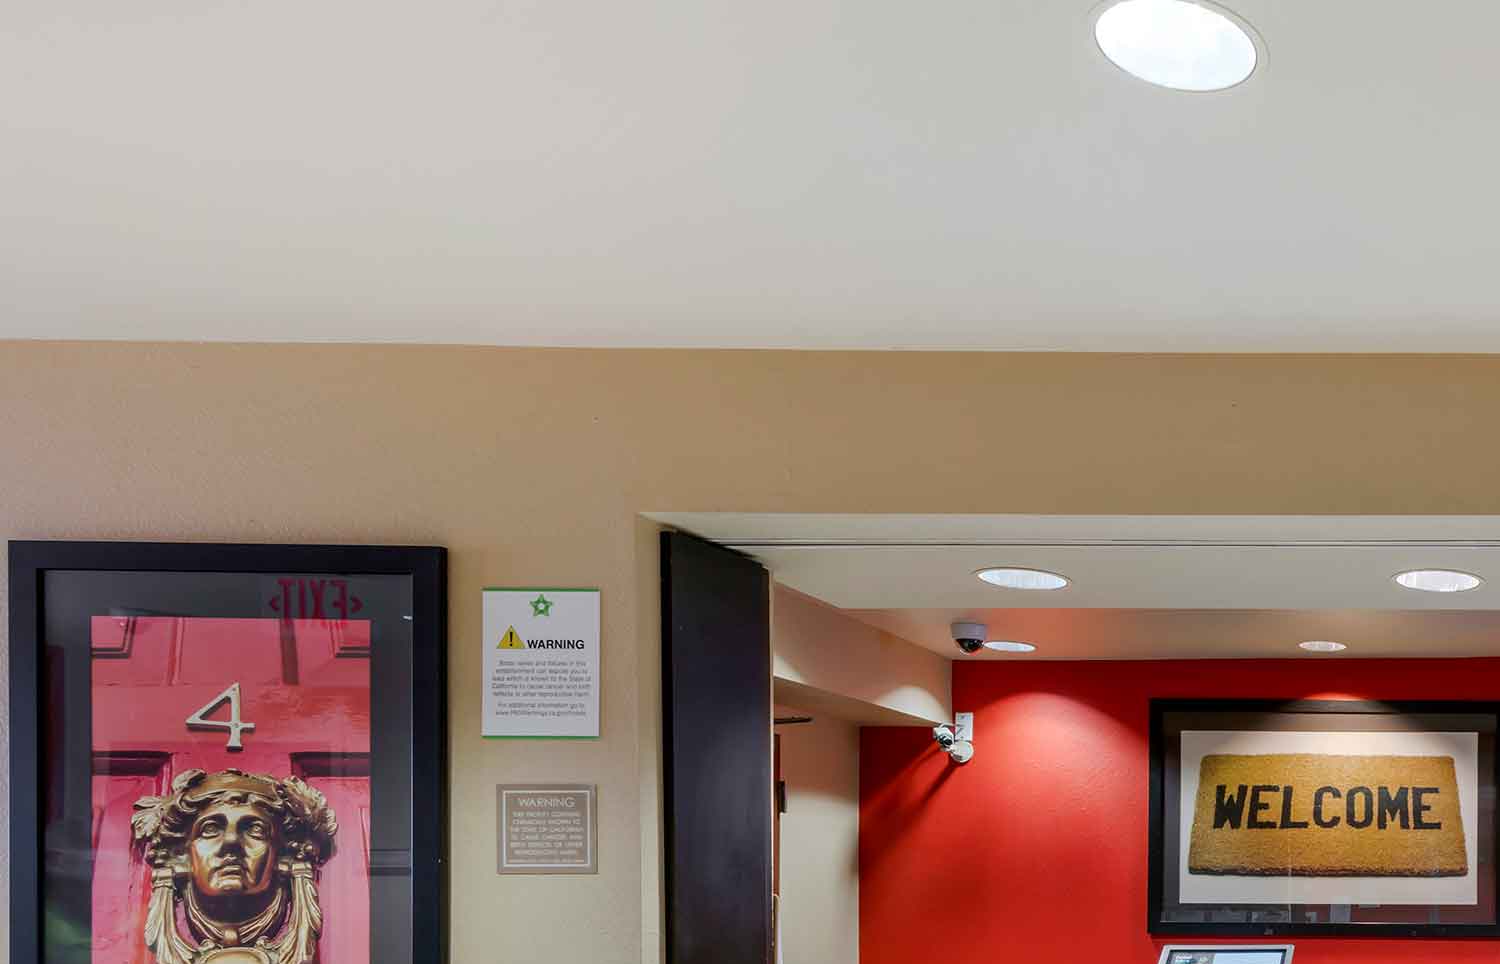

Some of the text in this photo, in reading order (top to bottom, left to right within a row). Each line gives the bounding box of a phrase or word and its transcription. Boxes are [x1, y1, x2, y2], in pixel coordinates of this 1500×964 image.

[527, 639, 585, 650] WARNING
[185, 682, 256, 749] 4
[516, 796, 576, 808] WARNING
[1212, 784, 1442, 830] WELCOME
